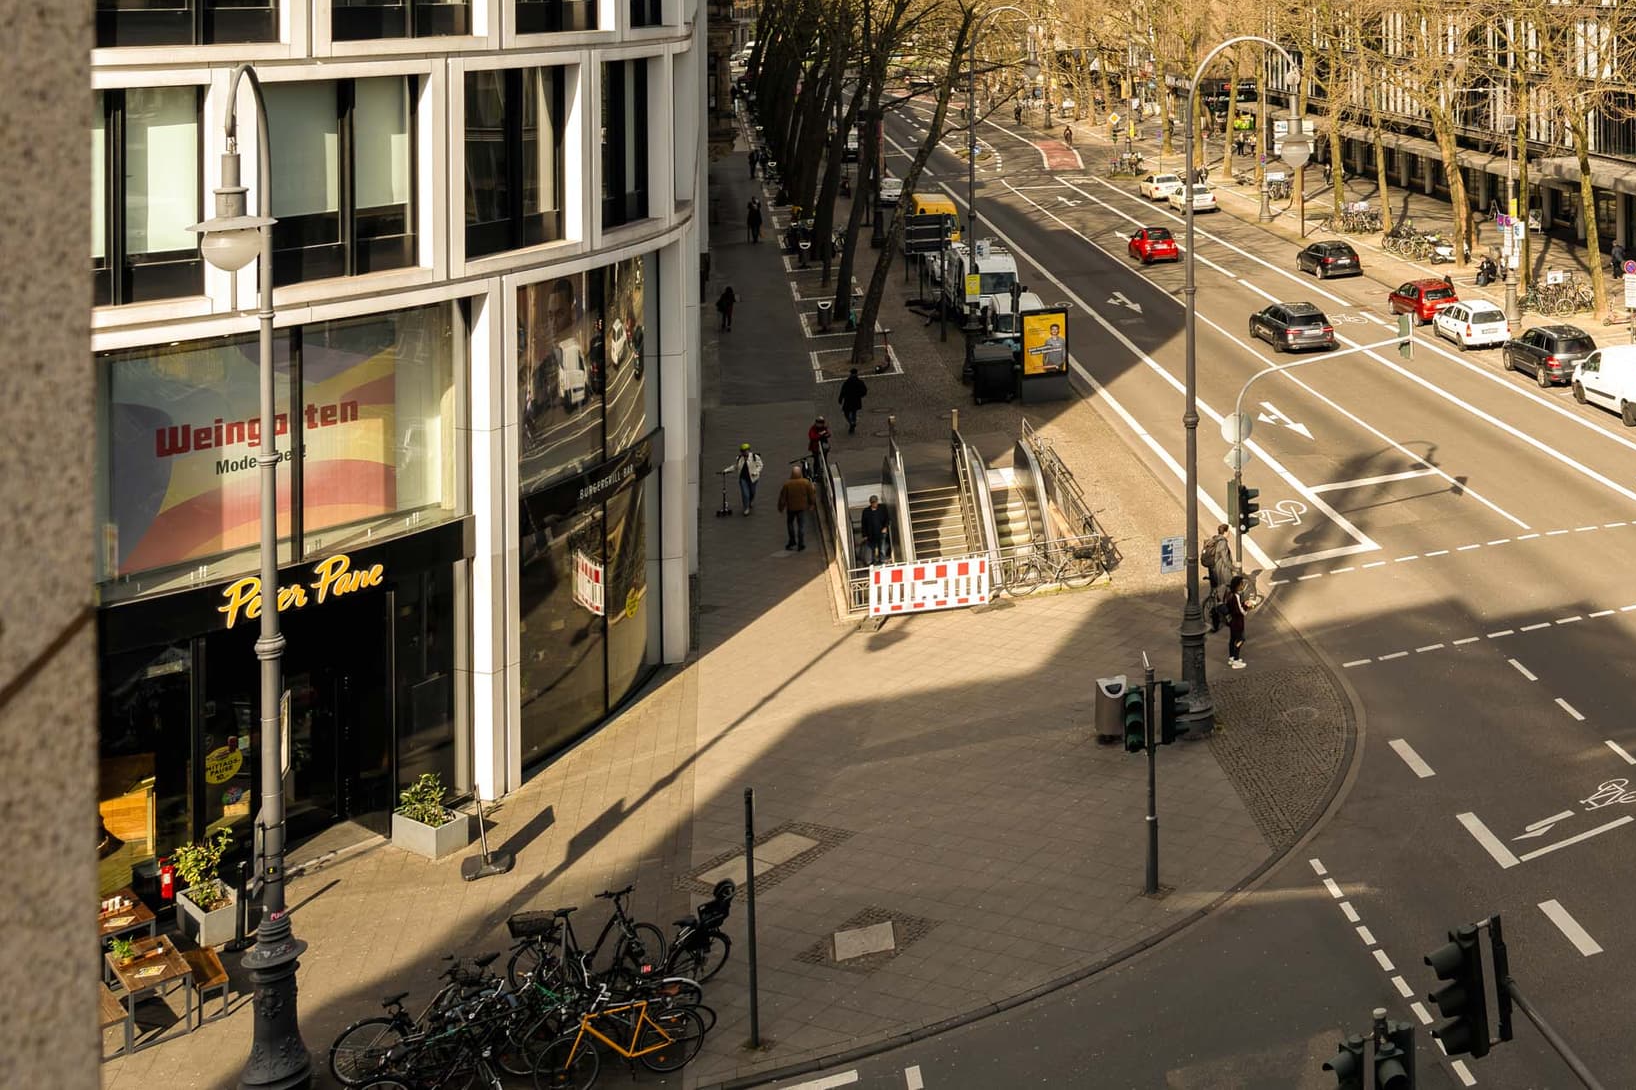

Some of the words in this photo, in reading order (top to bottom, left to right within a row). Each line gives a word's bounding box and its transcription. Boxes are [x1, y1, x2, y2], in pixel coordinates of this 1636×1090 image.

[156, 400, 359, 457] Weingaten
[216, 455, 257, 475] Mode
[217, 576, 309, 629] Peer
[310, 554, 384, 604] Pane
